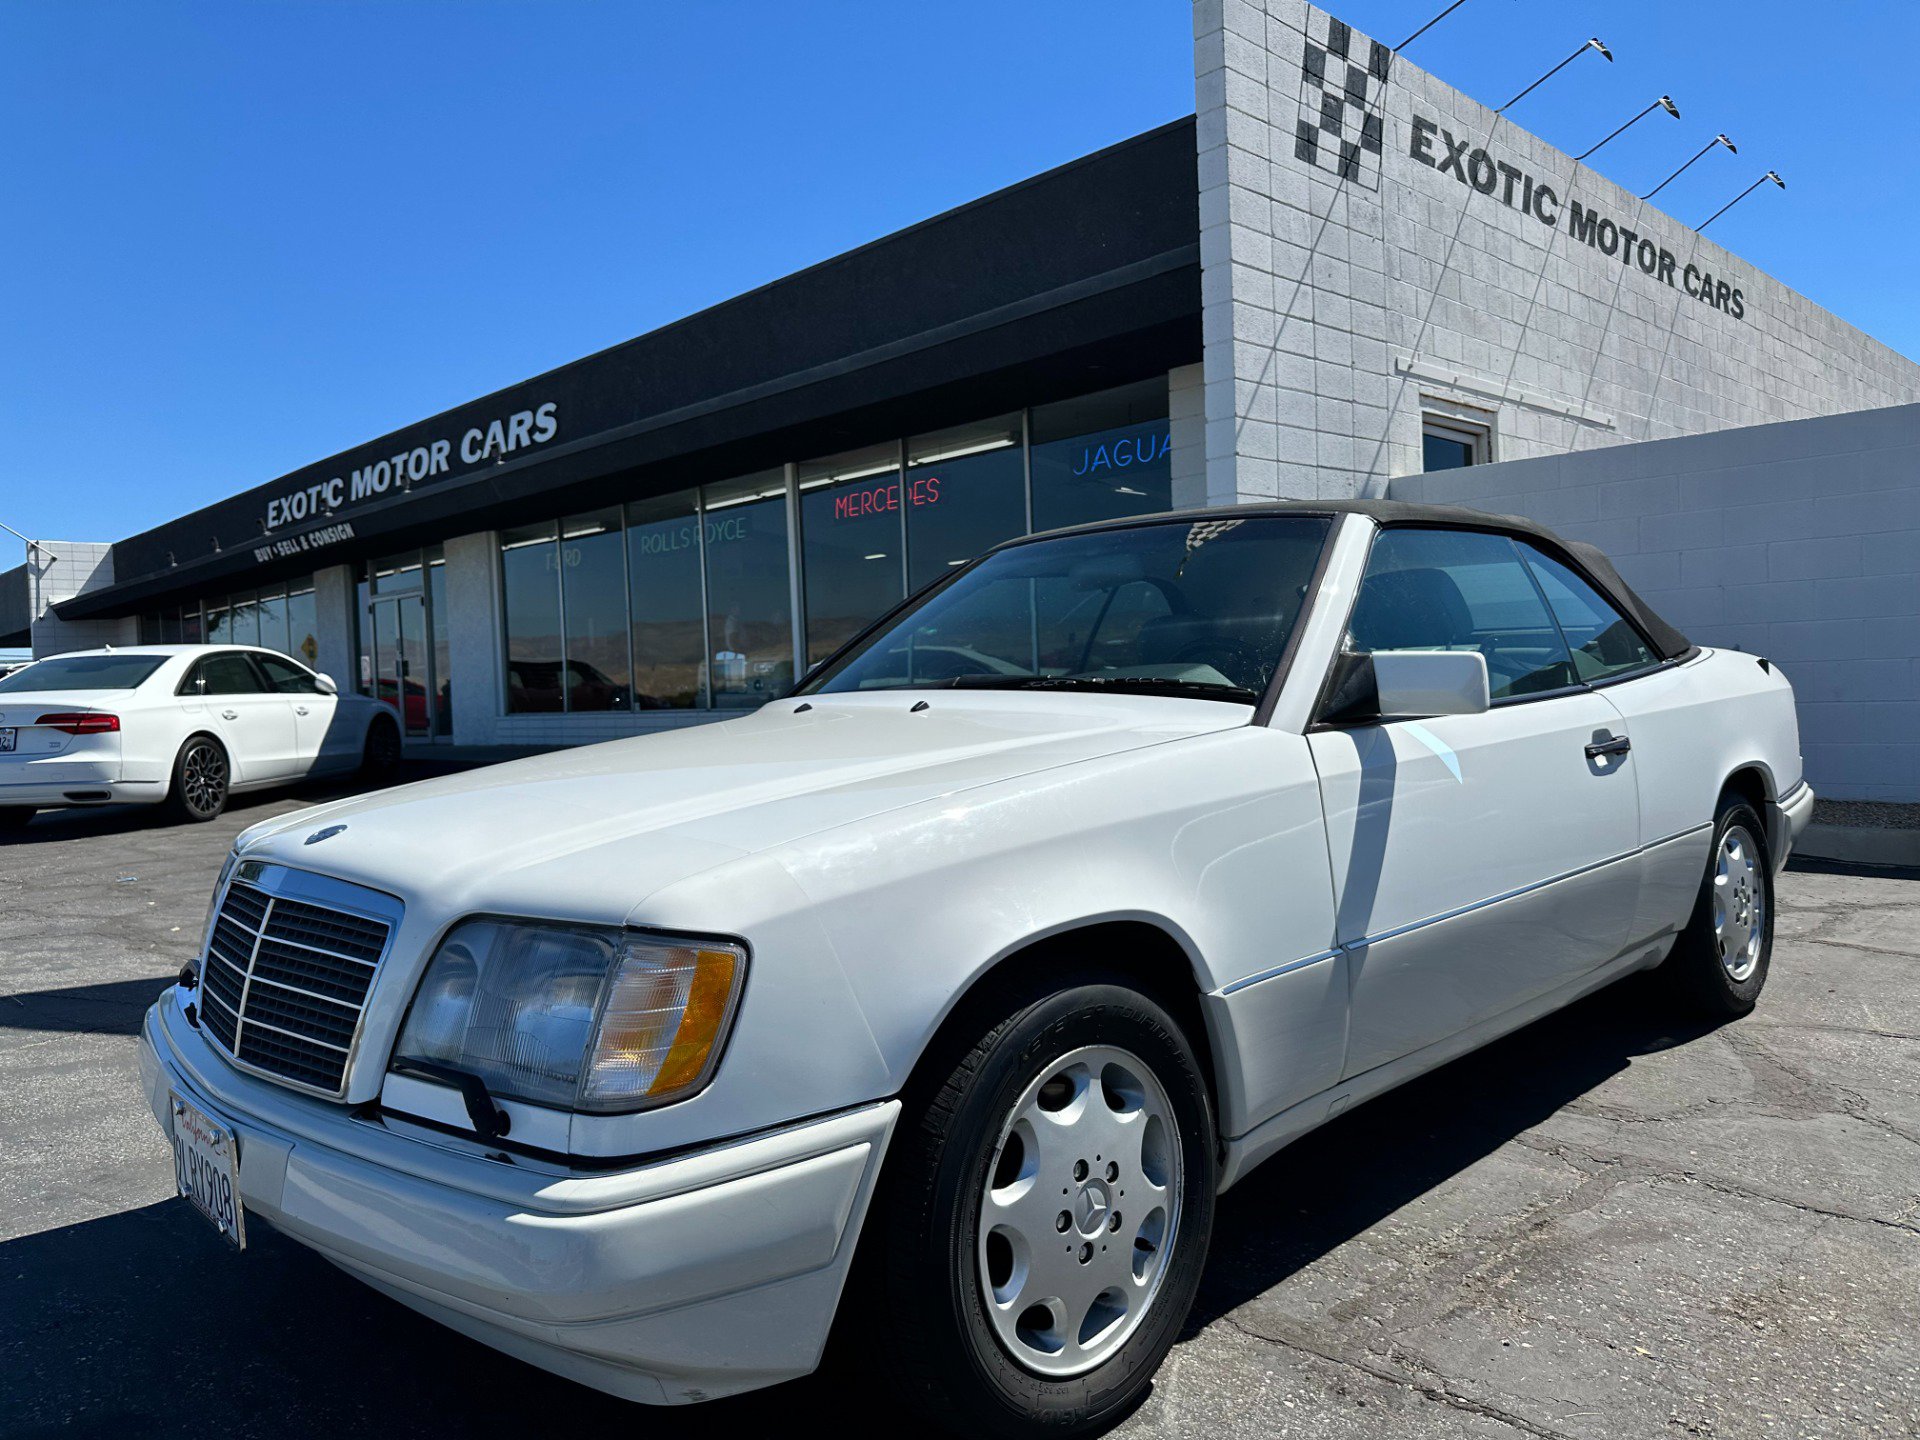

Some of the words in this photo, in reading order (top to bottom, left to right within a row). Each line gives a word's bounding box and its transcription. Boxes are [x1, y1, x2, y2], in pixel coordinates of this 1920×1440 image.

[1410, 114, 1558, 226] EXOTIC
[1569, 199, 1676, 288] MOTOR
[1683, 263, 1745, 320] CARS
[350, 439, 450, 501] MOTOR
[460, 401, 558, 464] CARS
[835, 477, 941, 519] MERCEES
[254, 545, 274, 562] BUY
[276, 538, 301, 556] SELL
[308, 522, 355, 548] CONSIGN
[640, 527, 690, 554] ROLLS
